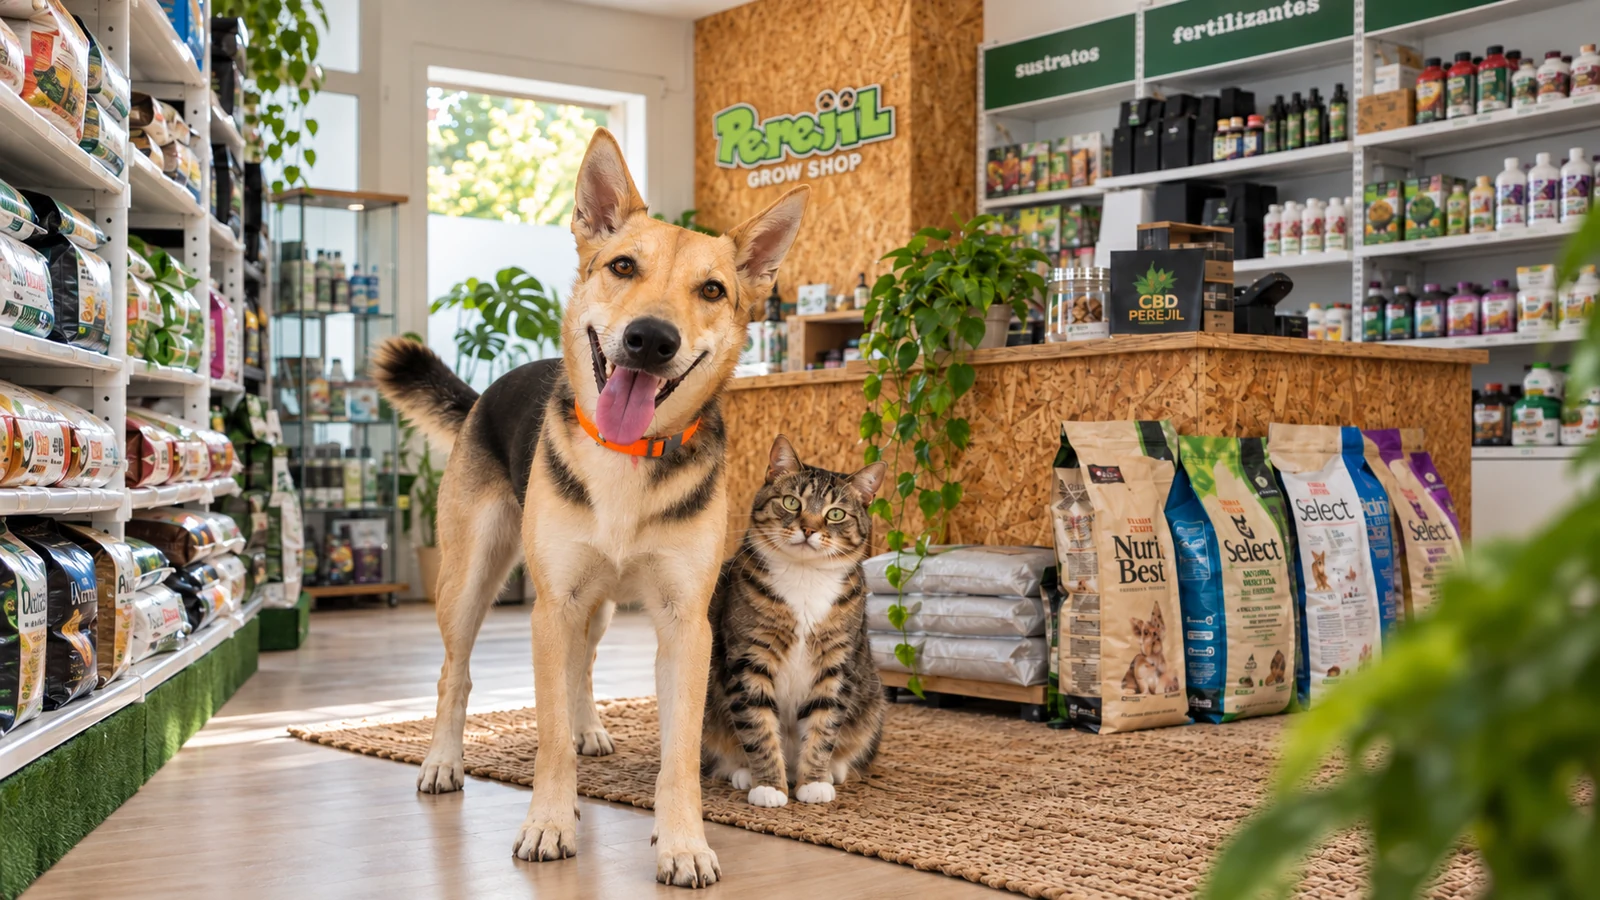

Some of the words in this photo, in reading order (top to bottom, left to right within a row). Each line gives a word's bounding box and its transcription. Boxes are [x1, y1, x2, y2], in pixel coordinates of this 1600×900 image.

[1172, 0, 1320, 45] fertilizantes
[1015, 47, 1100, 79] sustratos
[747, 162, 803, 189] GROW
[807, 153, 862, 179] SHOP
[1138, 294, 1179, 309] CBD
[1129, 309, 1185, 321] PEREJIL
[1295, 498, 1355, 522] Select
[1408, 519, 1452, 541] Select
[1223, 538, 1282, 563] Select
[1116, 559, 1166, 584] Best
